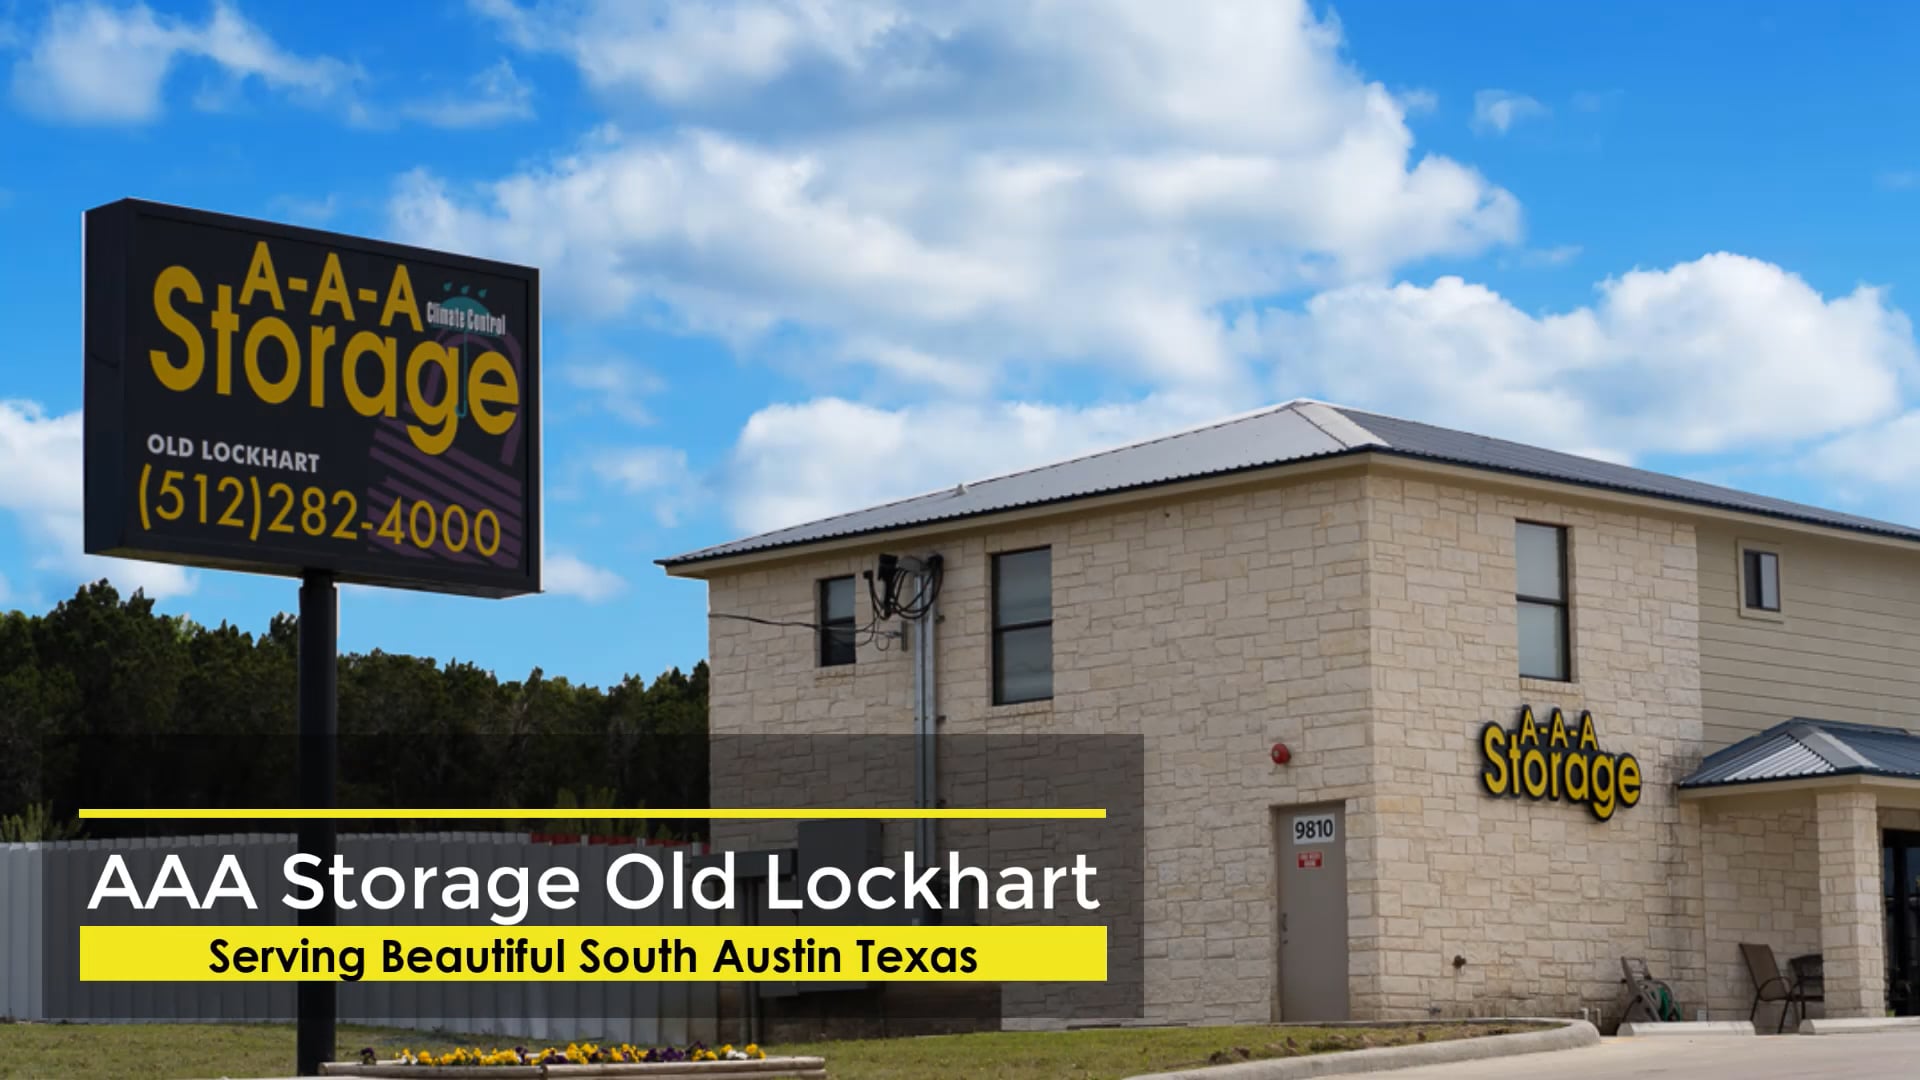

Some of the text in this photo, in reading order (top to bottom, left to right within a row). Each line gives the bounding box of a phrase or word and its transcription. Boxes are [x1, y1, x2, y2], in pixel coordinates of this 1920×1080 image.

[238, 241, 424, 333] A-A-A
[427, 301, 506, 335] Climate Control
[149, 265, 519, 456] Storage
[147, 433, 320, 474] OLD LOCKHART
[139, 463, 501, 557] (512)282-4000
[1520, 708, 1599, 751] A-A-A
[1484, 725, 1642, 819] Storage
[1295, 818, 1334, 840] 9810
